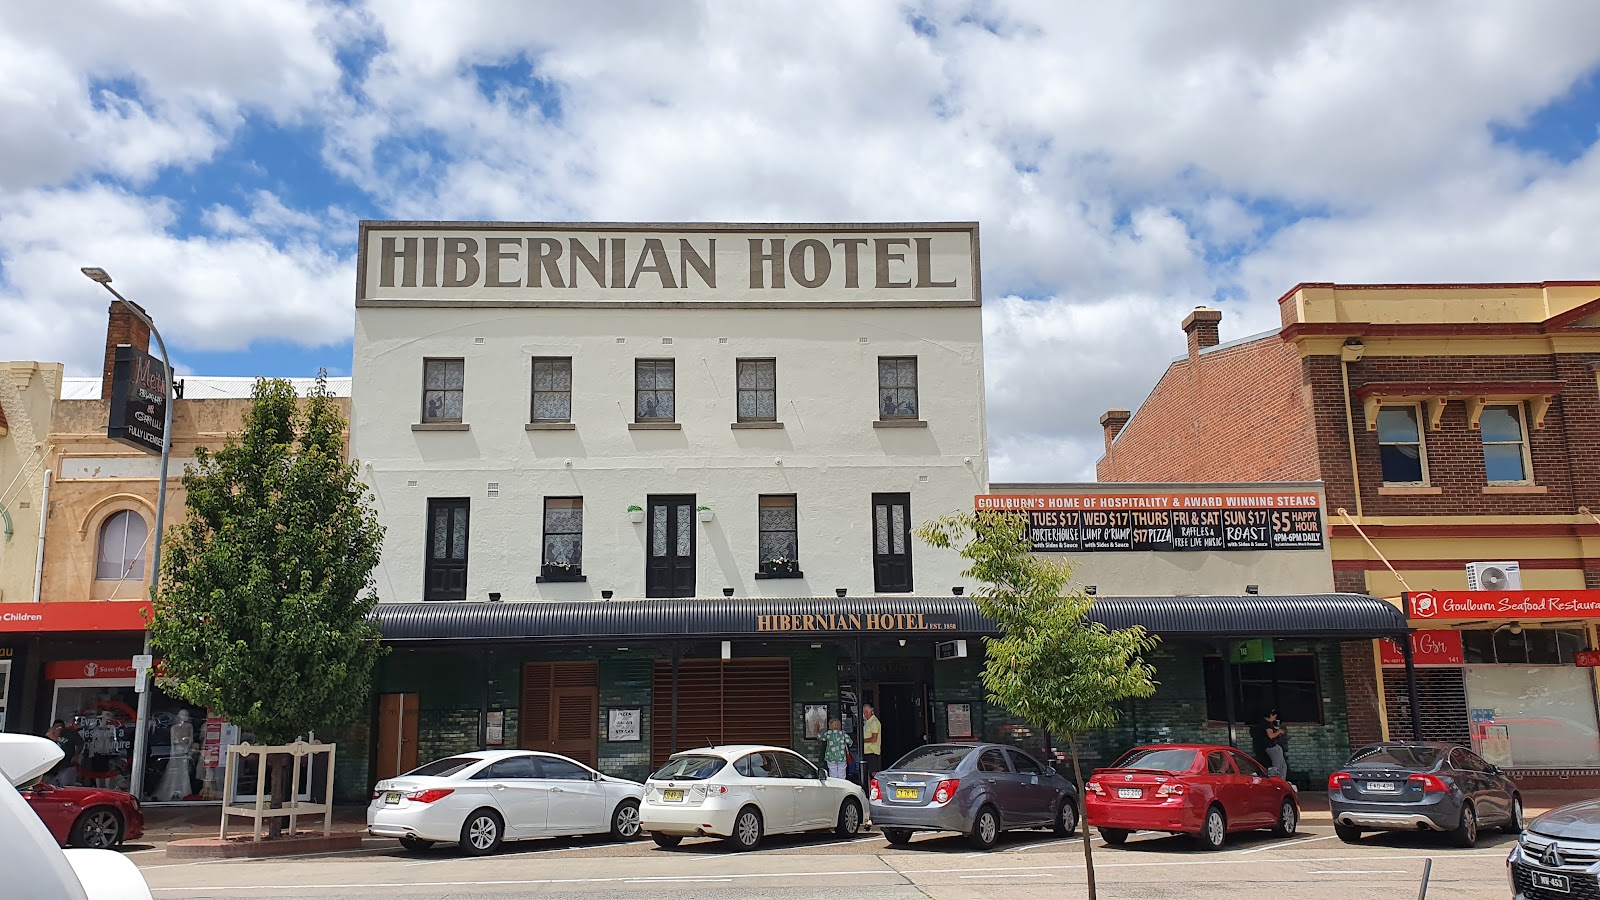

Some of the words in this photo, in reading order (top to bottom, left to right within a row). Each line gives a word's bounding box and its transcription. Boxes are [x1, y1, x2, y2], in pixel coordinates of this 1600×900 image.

[379, 236, 716, 288] HIBERNIAN
[747, 236, 957, 289] HOTEL
[128, 425, 144, 437] FULLY
[978, 498, 1045, 508] GOULBURN'S
[1048, 498, 1080, 508] HOME
[1083, 497, 1096, 507] OF
[1100, 497, 1168, 507] HOSPITALITY
[1172, 497, 1180, 507] &
[1184, 497, 1222, 507] AWARD
[1226, 496, 1274, 506] WINNING
[1277, 496, 1316, 506] STEAKS
[1032, 512, 1057, 526] TUES
[1059, 511, 1079, 527] $17
[1083, 512, 1107, 526] WED
[1109, 511, 1129, 527] $17
[1132, 511, 1169, 526] THURS
[1173, 511, 1189, 525] FRI
[1191, 511, 1200, 525] &
[1200, 511, 1220, 525] SAT
[1224, 511, 1246, 525] SUN
[1247, 510, 1267, 526] $17
[1271, 511, 1291, 532] $5
[1291, 511, 1317, 521] HAPPY
[1181, 526, 1209, 537] RAFFLES
[1295, 521, 1318, 531] HOUR
[1031, 528, 1079, 541] PORTERHOUSE
[1082, 528, 1102, 541] LUMP
[1133, 528, 1148, 543] $17
[1148, 528, 1172, 543] PIZZA
[1226, 526, 1267, 541] ROAST
[1273, 533, 1302, 542] 4PM-6PM
[1302, 532, 1320, 542] DAILY
[1174, 537, 1189, 547] FREE
[1190, 537, 1203, 547] LIVE
[1204, 537, 1223, 547] MUSIC
[1443, 598, 1495, 612] Goulburn
[1497, 597, 1546, 613] Seafood
[3, 612, 43, 621] Children
[757, 614, 861, 631] HIBERNIAN
[866, 613, 928, 630] HOTEL
